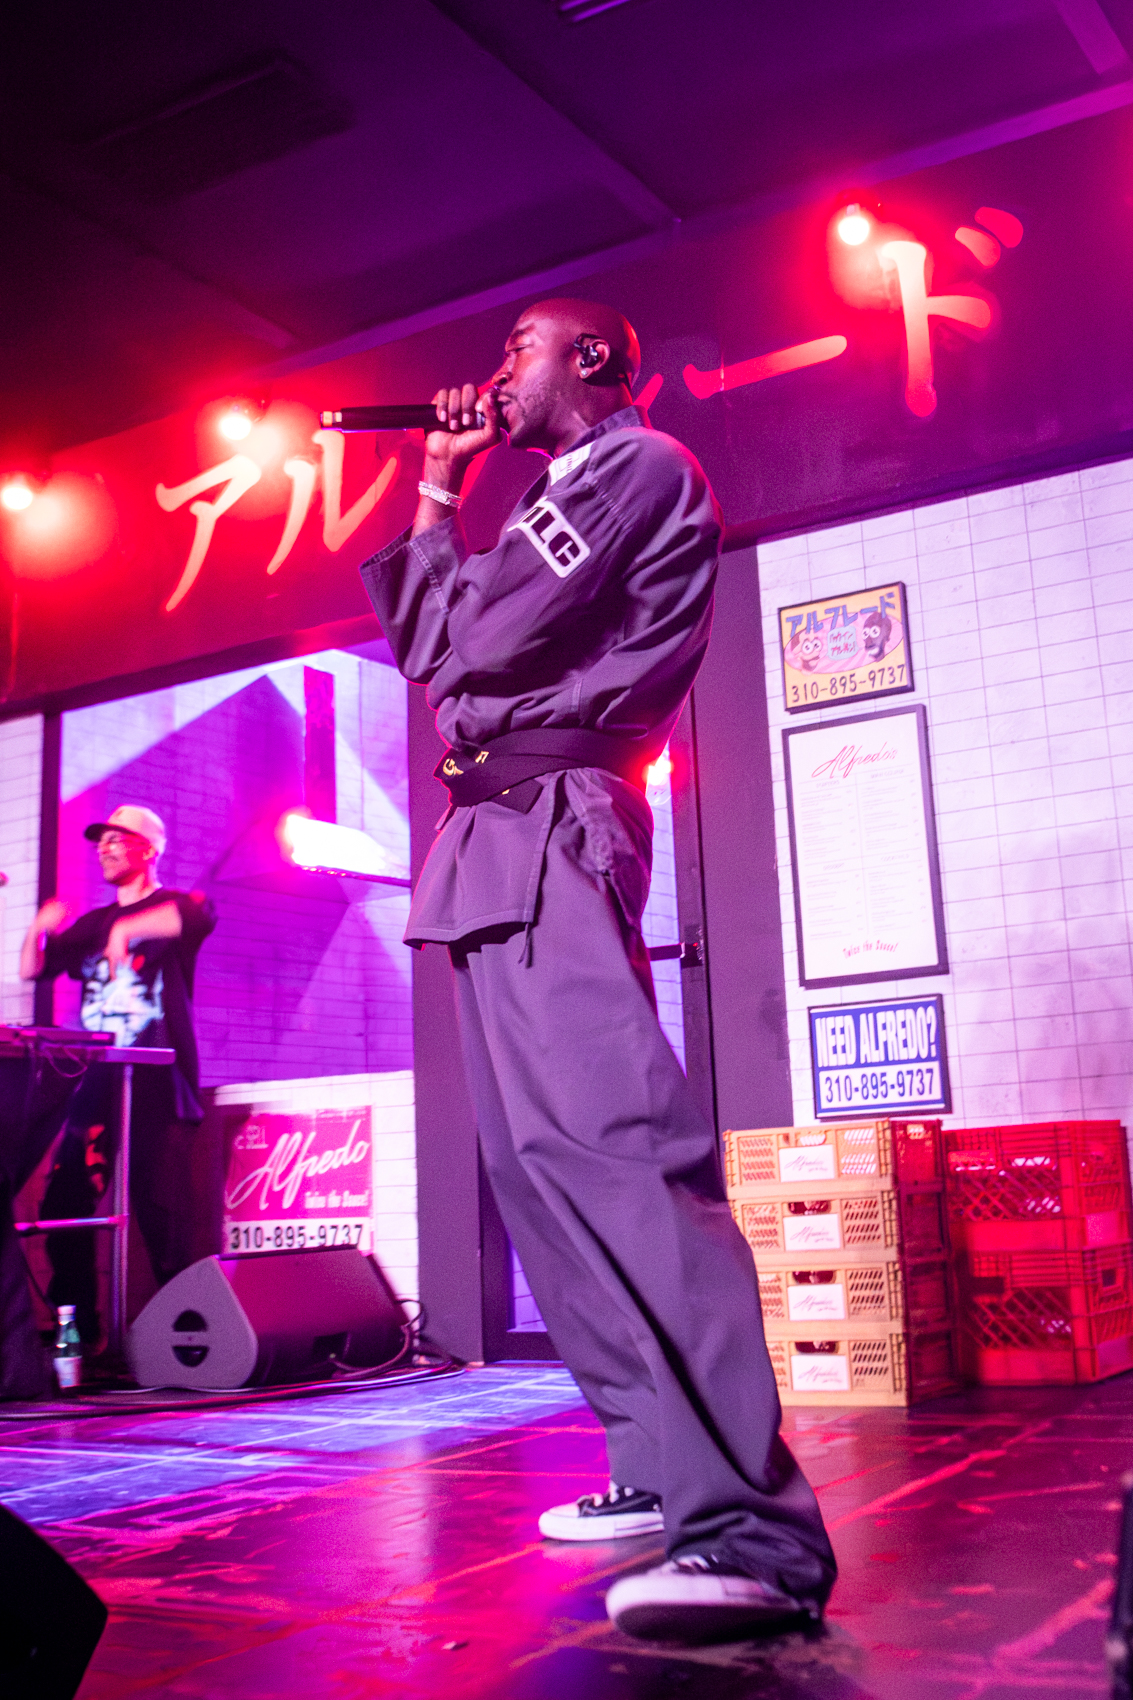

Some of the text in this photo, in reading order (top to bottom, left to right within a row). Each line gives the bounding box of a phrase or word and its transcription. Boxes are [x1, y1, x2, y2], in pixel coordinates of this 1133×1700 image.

[786, 592, 896, 638] アルフレード
[791, 664, 906, 702] 310-895-9737
[815, 1005, 937, 1068] NEED ALFREDO?
[825, 1068, 934, 1103] 310-895-9737
[225, 1119, 370, 1210] Alfredo
[230, 1223, 363, 1250] 310-895-9737
